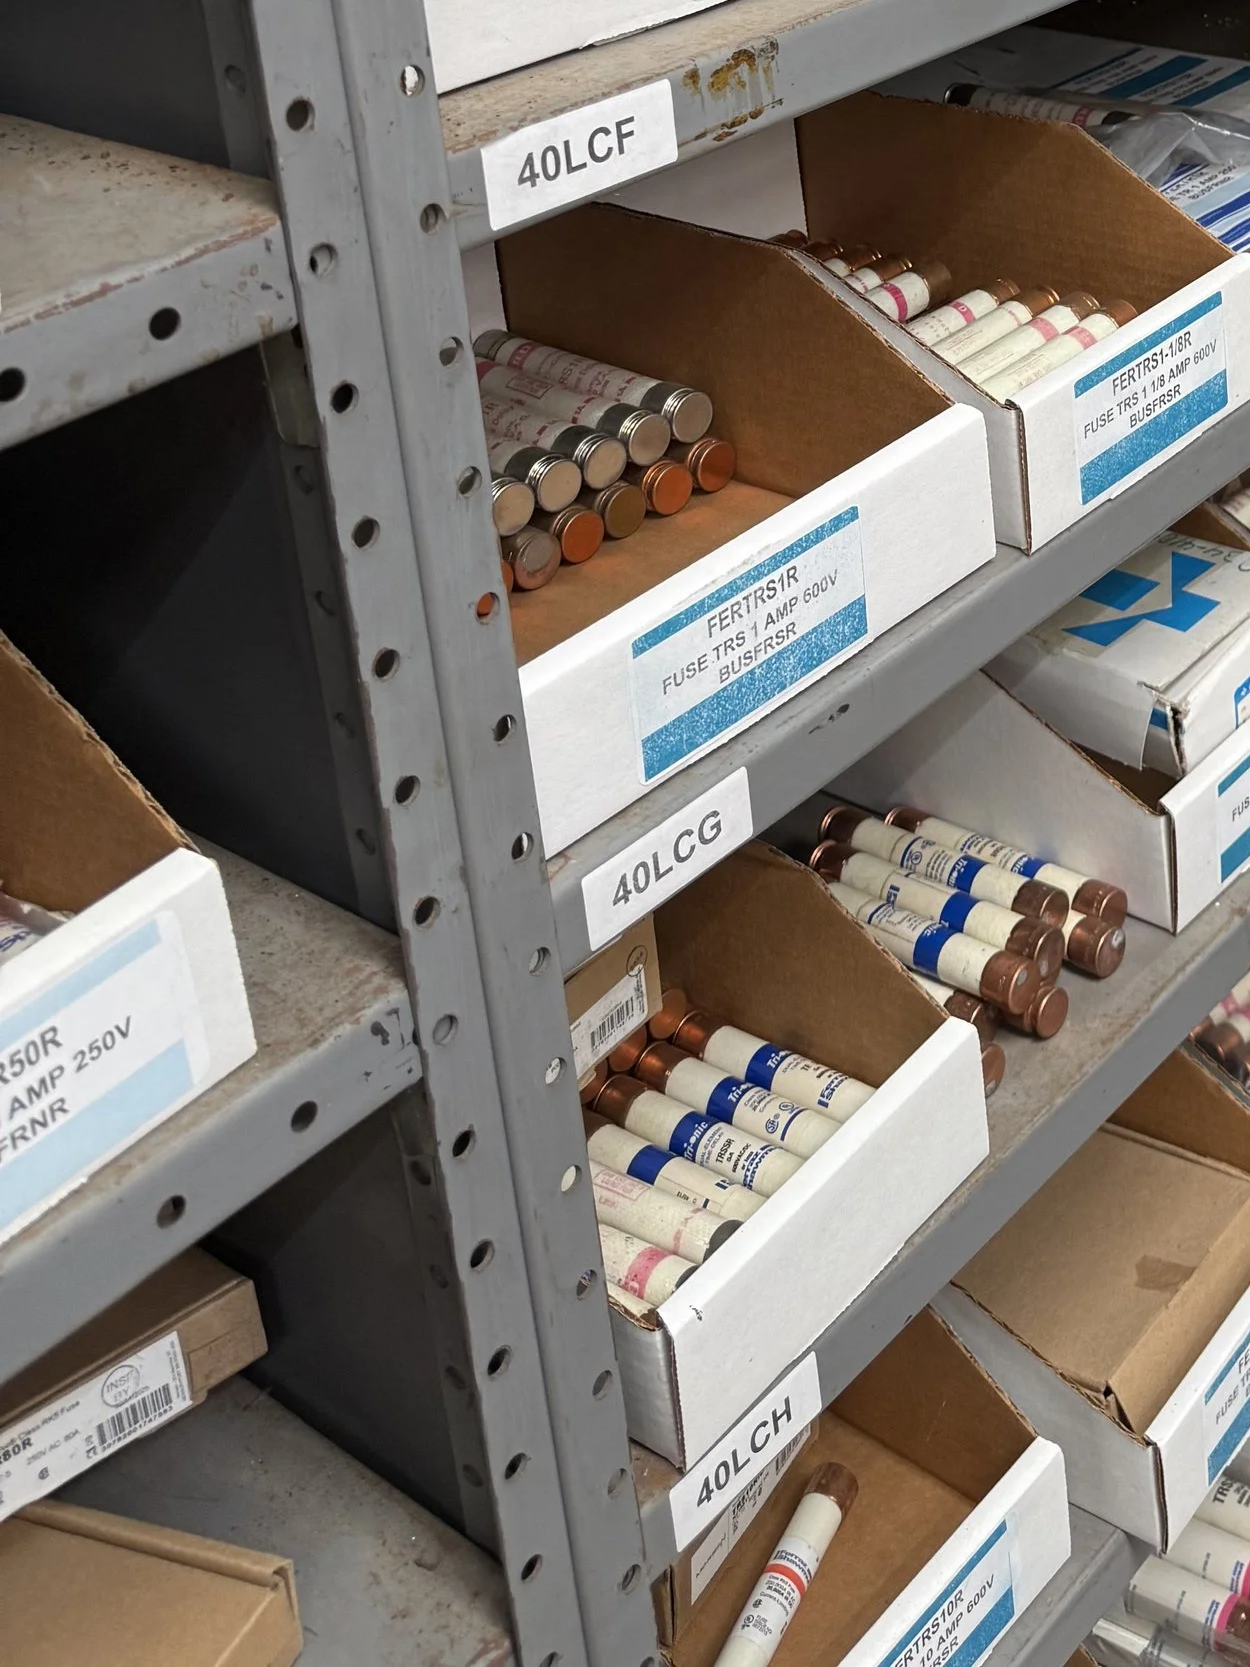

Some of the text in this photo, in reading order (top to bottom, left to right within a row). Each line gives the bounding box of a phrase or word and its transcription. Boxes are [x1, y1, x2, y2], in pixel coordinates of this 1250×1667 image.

[517, 116, 636, 188] 40LCF
[1084, 339, 1218, 439] FUSE TRS 1 1/8 AMP 600V
[1111, 331, 1192, 397] FERTRS1-1/8R
[1129, 384, 1182, 430] BUSFRSR
[662, 569, 839, 696] FUSE TRS 1 AMP 600V
[707, 565, 800, 639] FERTRS1R
[718, 621, 797, 685] BUSFRSR
[612, 810, 723, 908] 40LCG
[9, 1015, 131, 1121] AMP 250V
[1215, 1386, 1239, 1425] FUSE
[696, 1396, 792, 1509] 40LCH
[937, 1612, 963, 1650] AMP
[967, 1574, 994, 1614] 600V
